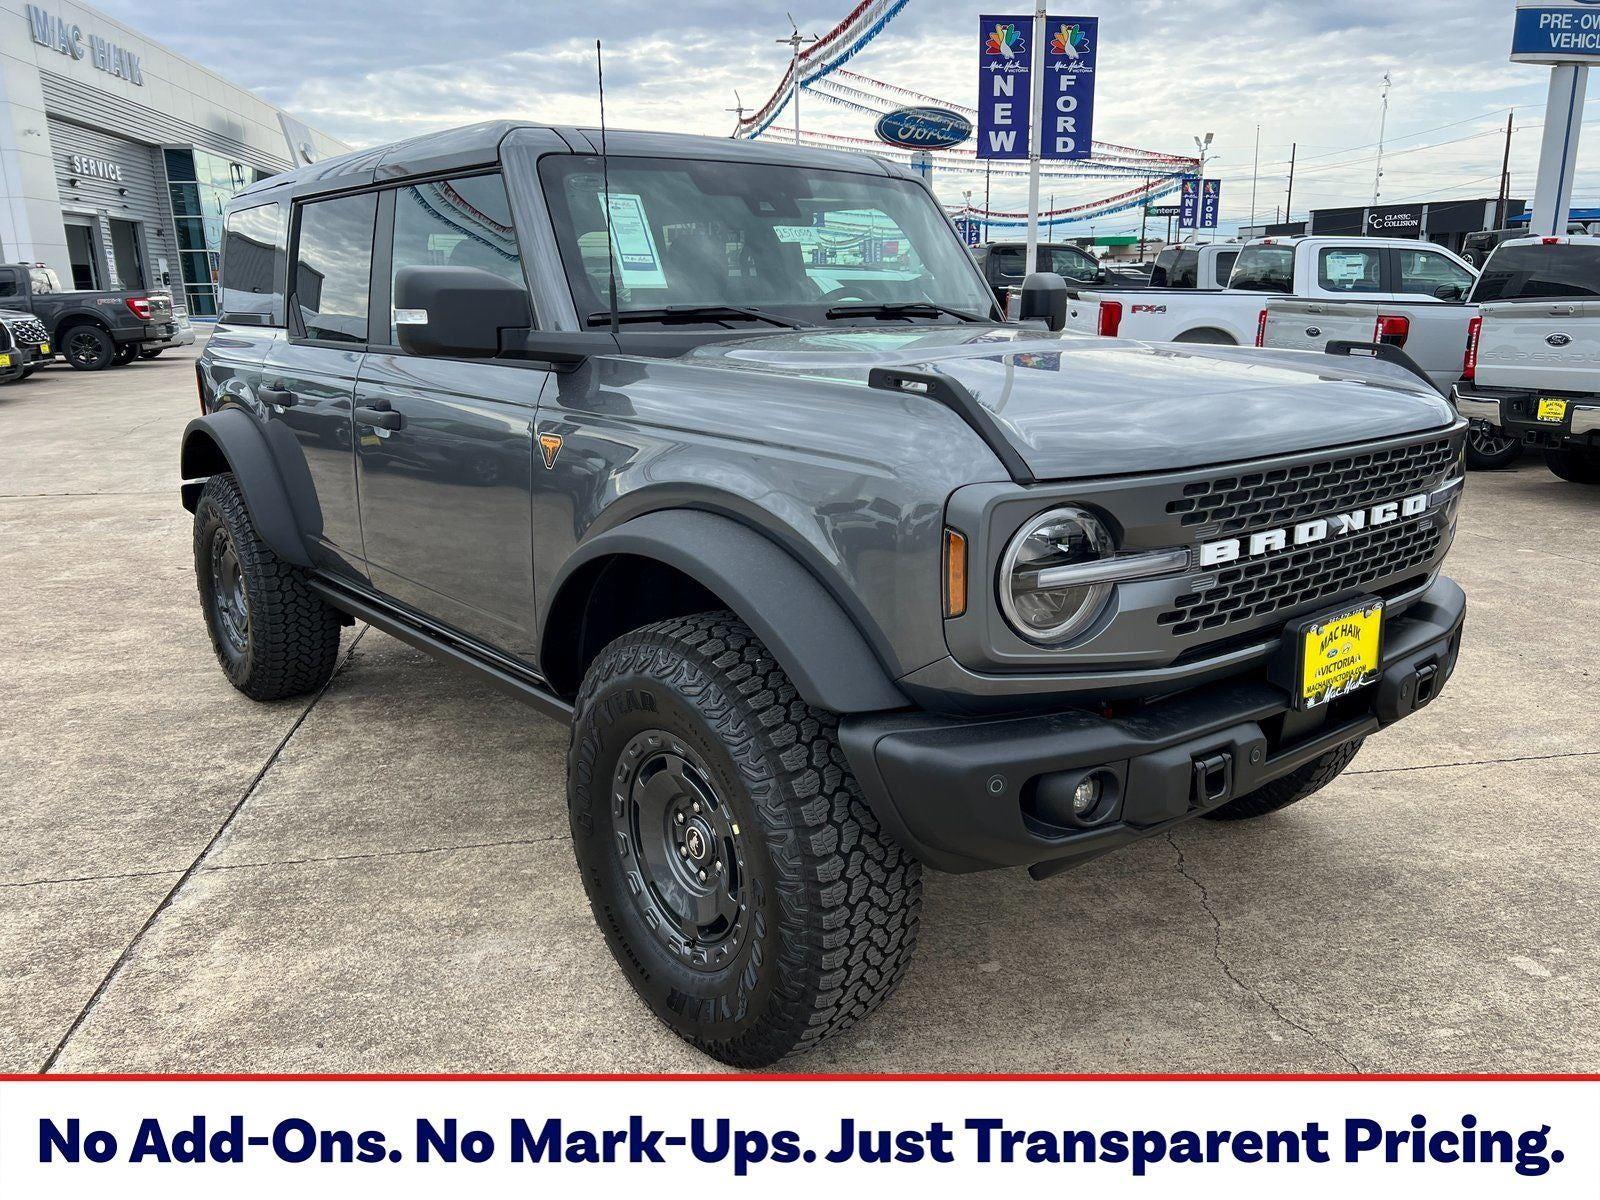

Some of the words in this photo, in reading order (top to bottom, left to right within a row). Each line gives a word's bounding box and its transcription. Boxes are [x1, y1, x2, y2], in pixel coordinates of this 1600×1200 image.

[27, 4, 85, 60] MAC
[88, 34, 144, 86] HAIK
[898, 114, 957, 140] Ford
[988, 75, 1017, 152] NEW
[1056, 75, 1078, 153] FORD
[73, 155, 122, 181] SERVICE
[1149, 207, 1180, 216] enterp
[1183, 198, 1194, 227] NEW
[1205, 198, 1213, 227] FORD
[1385, 213, 1411, 221] CLASSIC
[1131, 305, 1167, 313] FX4
[1485, 351, 1563, 362] SUPER
[1200, 494, 1428, 567] BRONCO
[1319, 626, 1340, 655] MAC
[1341, 624, 1361, 641] HAIK
[1306, 664, 1367, 694] MACHAIKVICTORIA.COM
[1321, 655, 1355, 677] VICTORIA
